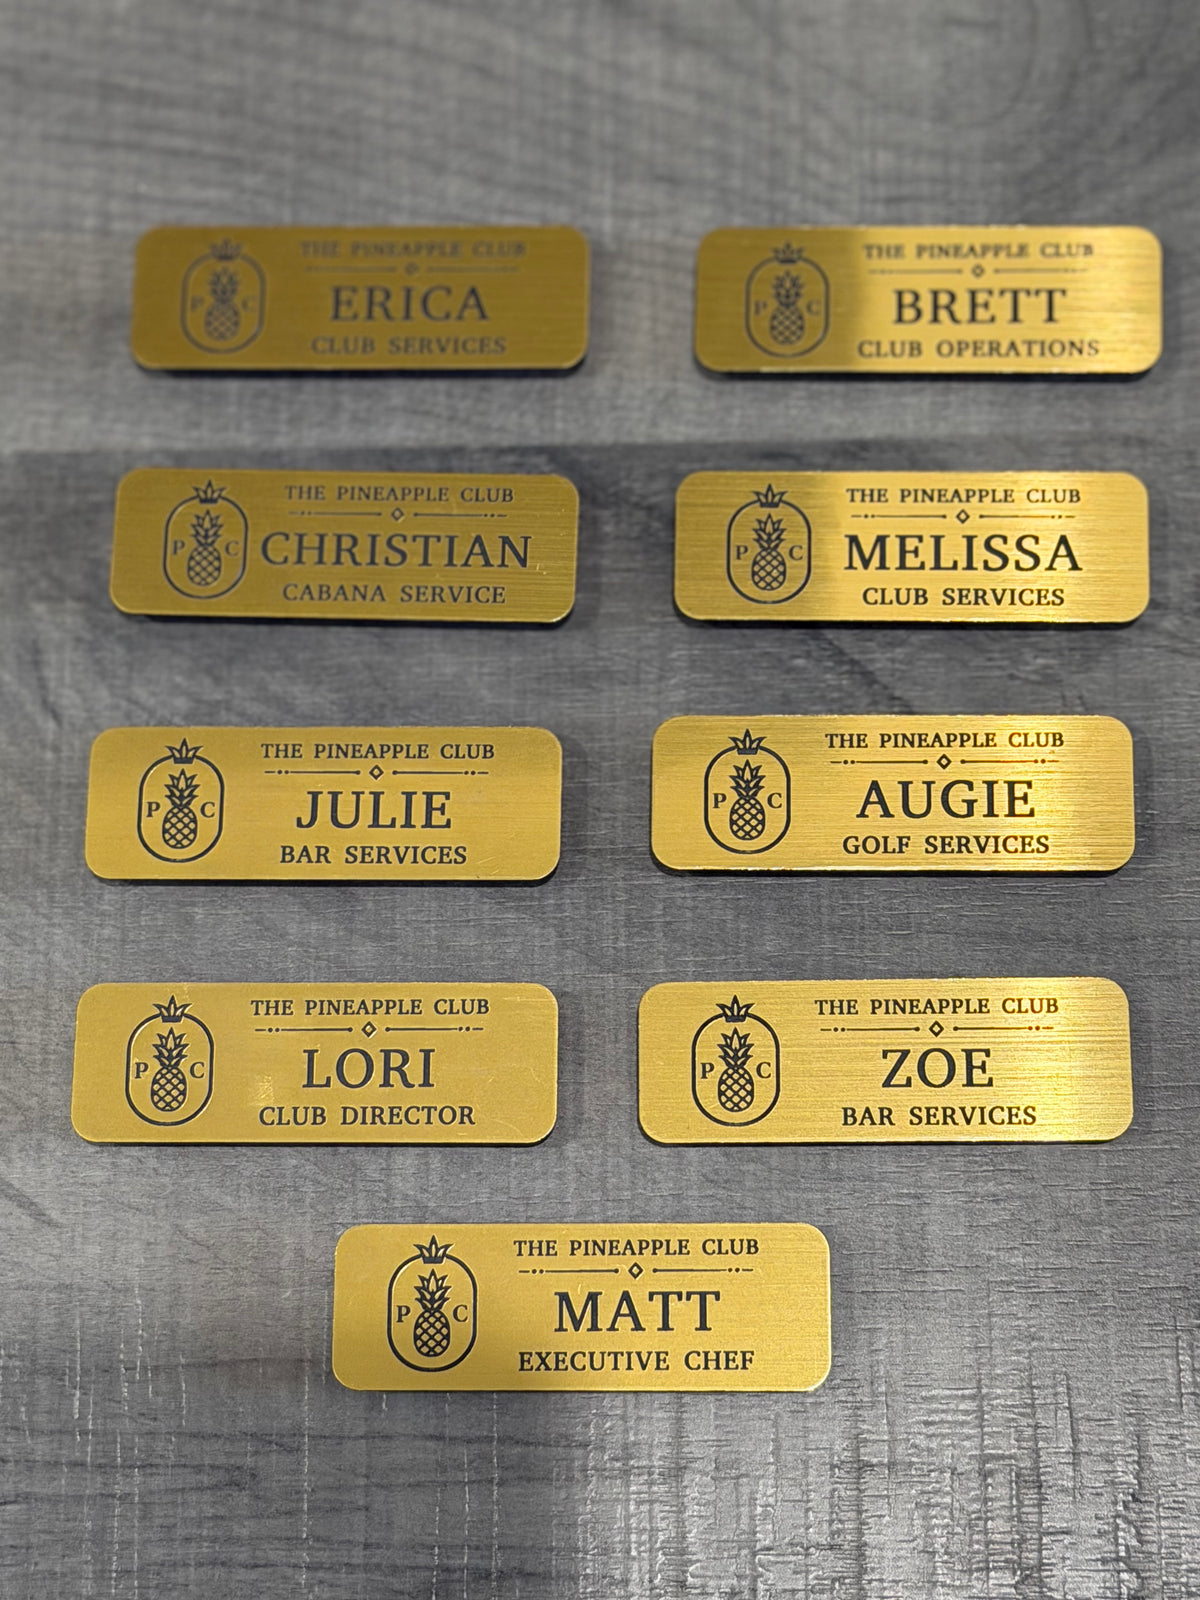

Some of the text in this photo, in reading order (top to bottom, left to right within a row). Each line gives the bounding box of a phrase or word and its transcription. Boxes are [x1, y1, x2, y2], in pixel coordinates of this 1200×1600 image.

[300, 241, 526, 257] THE PINEAPPLE CLUB
[864, 243, 1094, 258] THE PINEAPPLE CLUB
[330, 286, 490, 322] ERICA
[754, 301, 821, 316] P C
[893, 288, 1067, 325] BRETT
[311, 337, 506, 356] CLUB SERVICES
[858, 340, 1099, 358] CLUB OPERATIONS
[285, 484, 514, 503] THE PINEAPPLE CLUB
[846, 489, 1081, 504] THE PINEAPPLE CLUB
[172, 540, 240, 556] P C
[261, 532, 531, 568] CHRISTIAN
[735, 545, 803, 561] P C
[843, 534, 1083, 571] MELISSA
[282, 583, 506, 604] CABANA SERVICE
[862, 588, 1064, 607] CLUB SERVICES
[825, 732, 1064, 748] THE PINEAPPLE CLUB
[261, 743, 494, 759] THE PINEAPPLE CLUB
[713, 793, 782, 809] P C
[856, 780, 1035, 819] AUGIE
[146, 802, 215, 818] P C
[296, 791, 452, 829] JULIE
[842, 835, 1050, 854] GOLF SERVICES
[280, 845, 467, 864] BAR SERVICES
[250, 999, 490, 1016] THE PINEAPPLE CLUB
[815, 997, 1058, 1015] THE PINEAPPLE CLUB
[134, 1062, 205, 1078] P C
[302, 1048, 435, 1088] LORI
[700, 1062, 771, 1079] P C
[881, 1047, 994, 1088] ZOE
[259, 1105, 475, 1125] CLUB DIRECTOR
[842, 1106, 1036, 1126] BAR SERVICES
[513, 1239, 759, 1256] THE PINEAPPLE CLUB
[396, 1304, 468, 1323] P C
[554, 1291, 720, 1332] MATT
[518, 1350, 754, 1371] EXECUTIVE CHEF
